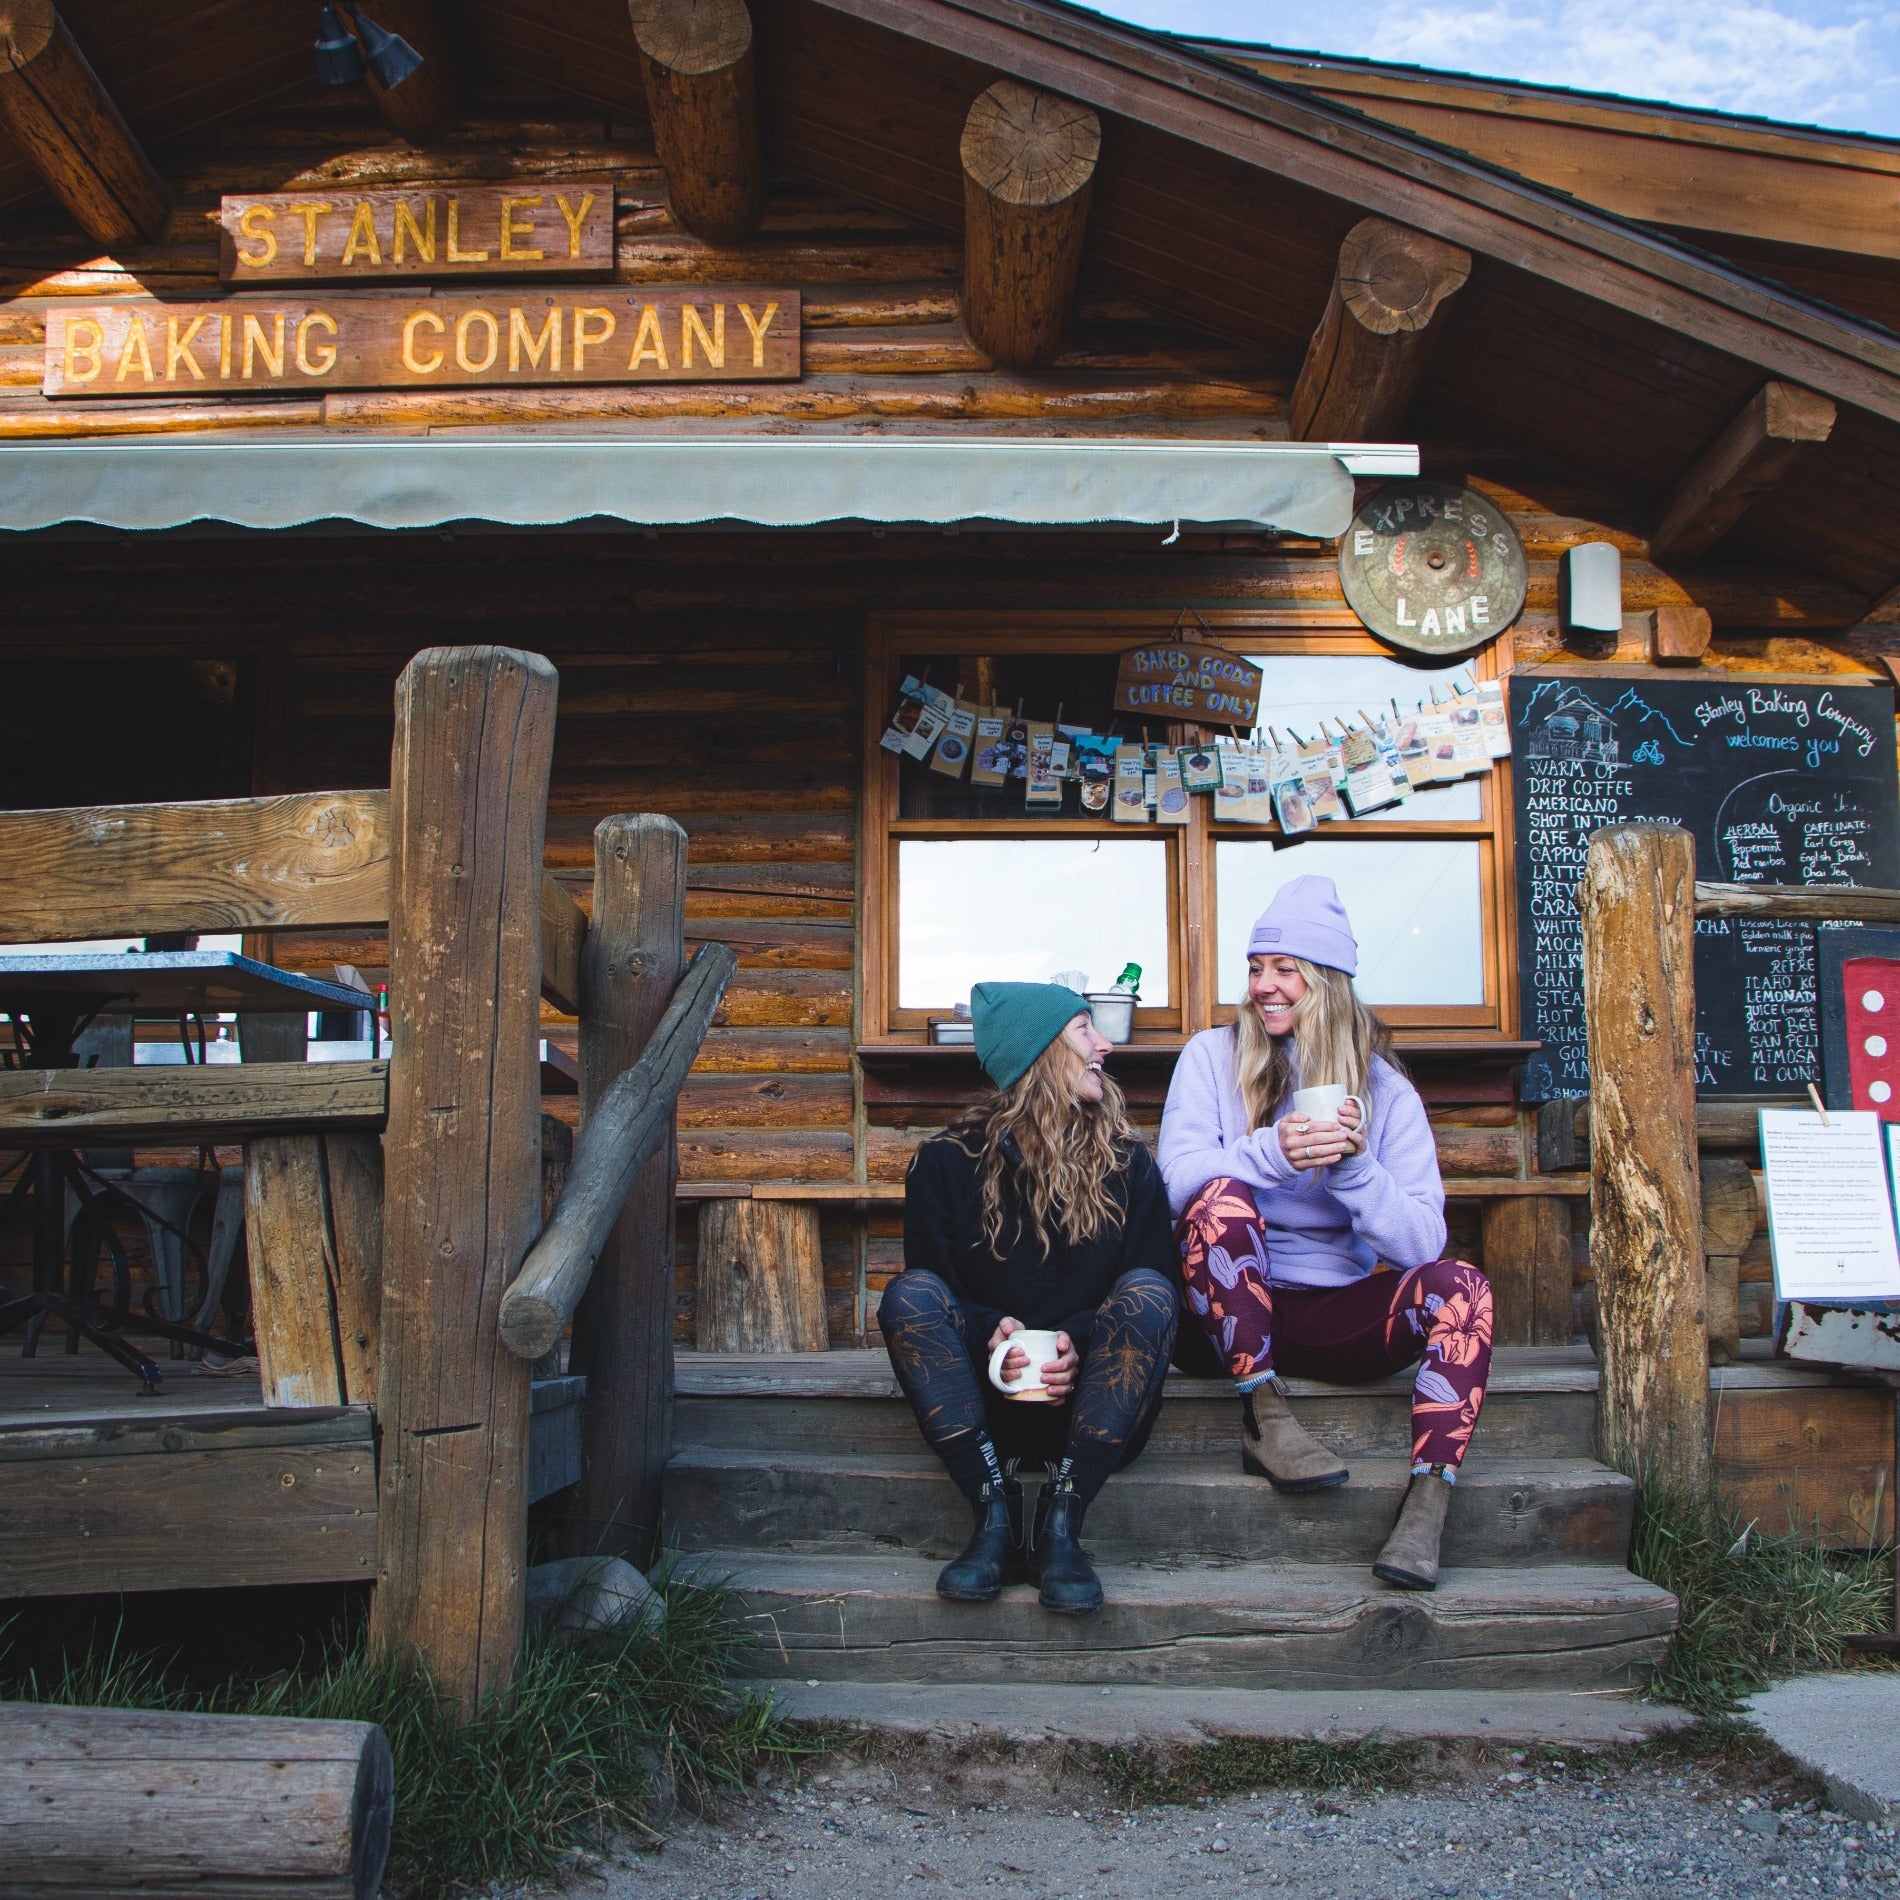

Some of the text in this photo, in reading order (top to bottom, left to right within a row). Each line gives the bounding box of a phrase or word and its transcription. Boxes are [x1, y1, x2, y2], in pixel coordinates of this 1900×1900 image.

[238, 194, 596, 268] STANLEY
[64, 303, 780, 383] BAKING COMPANY
[1354, 495, 1510, 556] EXPRESS
[1396, 596, 1490, 636] LANE
[1133, 649, 1256, 687] BAKED GOODS
[1171, 671, 1215, 690] AND
[1127, 684, 1257, 721] COFFEE ONLY
[1694, 696, 1746, 727] Stanley
[1817, 691, 1878, 757] Company
[1725, 725, 1839, 768] welcomes you
[1530, 760, 1619, 779] WARM UP
[1526, 778, 1633, 796] DRIP COFFEE
[1526, 797, 1618, 813] AMERICANO
[1769, 793, 1824, 823] Organic
[1529, 812, 1567, 828] SHOT
[1573, 814, 1591, 828] IN
[1727, 822, 1778, 836] HERBAL
[1529, 830, 1589, 846] CAFE A
[1804, 836, 1856, 853] Earl Grey
[1728, 840, 1783, 859] Peppermint
[1732, 856, 1752, 868] Red
[1532, 865, 1585, 880] LATTE
[1733, 870, 1765, 881] Lemon
[1803, 866, 1826, 878] Chai
[1531, 881, 1578, 898] BREV
[1530, 898, 1580, 916] CARA
[1741, 930, 1770, 940] Golden
[1535, 936, 1584, 952] MOCH
[1743, 941, 1782, 952] Turmeric
[1769, 958, 1815, 974] REFRE
[1534, 971, 1575, 988] CHAI
[1536, 989, 1585, 1007] STEA
[1747, 990, 1817, 1003] LEMONAD
[1536, 1008, 1573, 1024] HOT
[1744, 1003, 1778, 1021] JUICE
[1537, 1025, 1588, 1042] CRIMS
[1747, 1017, 1818, 1034] ROOT BEE
[1750, 1034, 1782, 1049] SAN
[1559, 1045, 1589, 1061] GOL
[1750, 1048, 1817, 1064] MIMOSA
[1561, 1061, 1591, 1079] MA
[1776, 1065, 1821, 1082] OUNC
[980, 1440, 998, 1467] WILD
